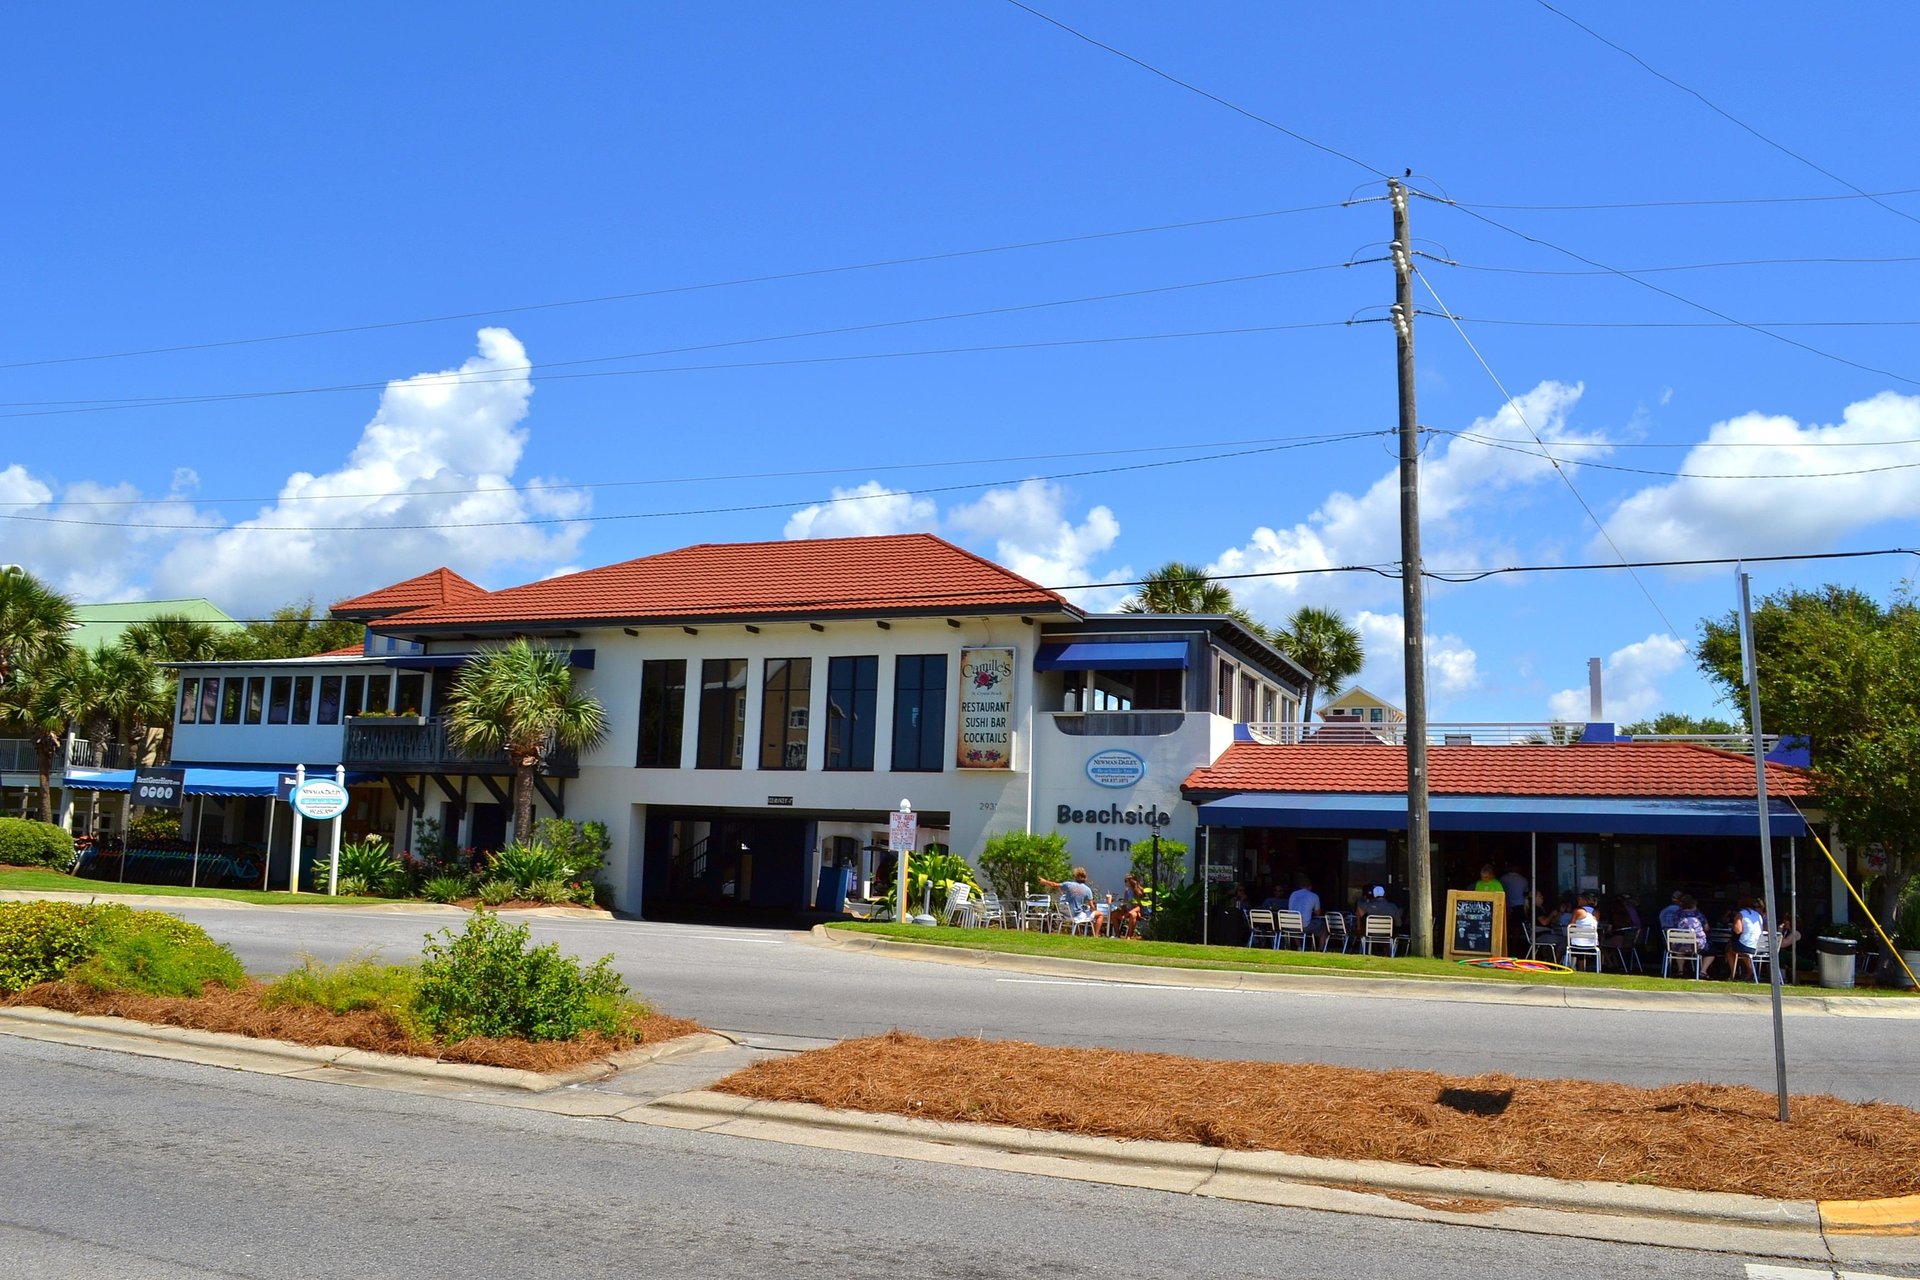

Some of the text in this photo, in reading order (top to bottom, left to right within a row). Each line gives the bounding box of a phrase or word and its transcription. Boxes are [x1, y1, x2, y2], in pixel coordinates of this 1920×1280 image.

[962, 659, 1012, 678] Camille's
[961, 701, 1011, 713] RESTAURANT
[965, 717, 1007, 728] SUSHI BAR
[963, 732, 1008, 743] COCKTAILS
[1057, 803, 1171, 826] Beachside
[1096, 832, 1131, 851] Inn
